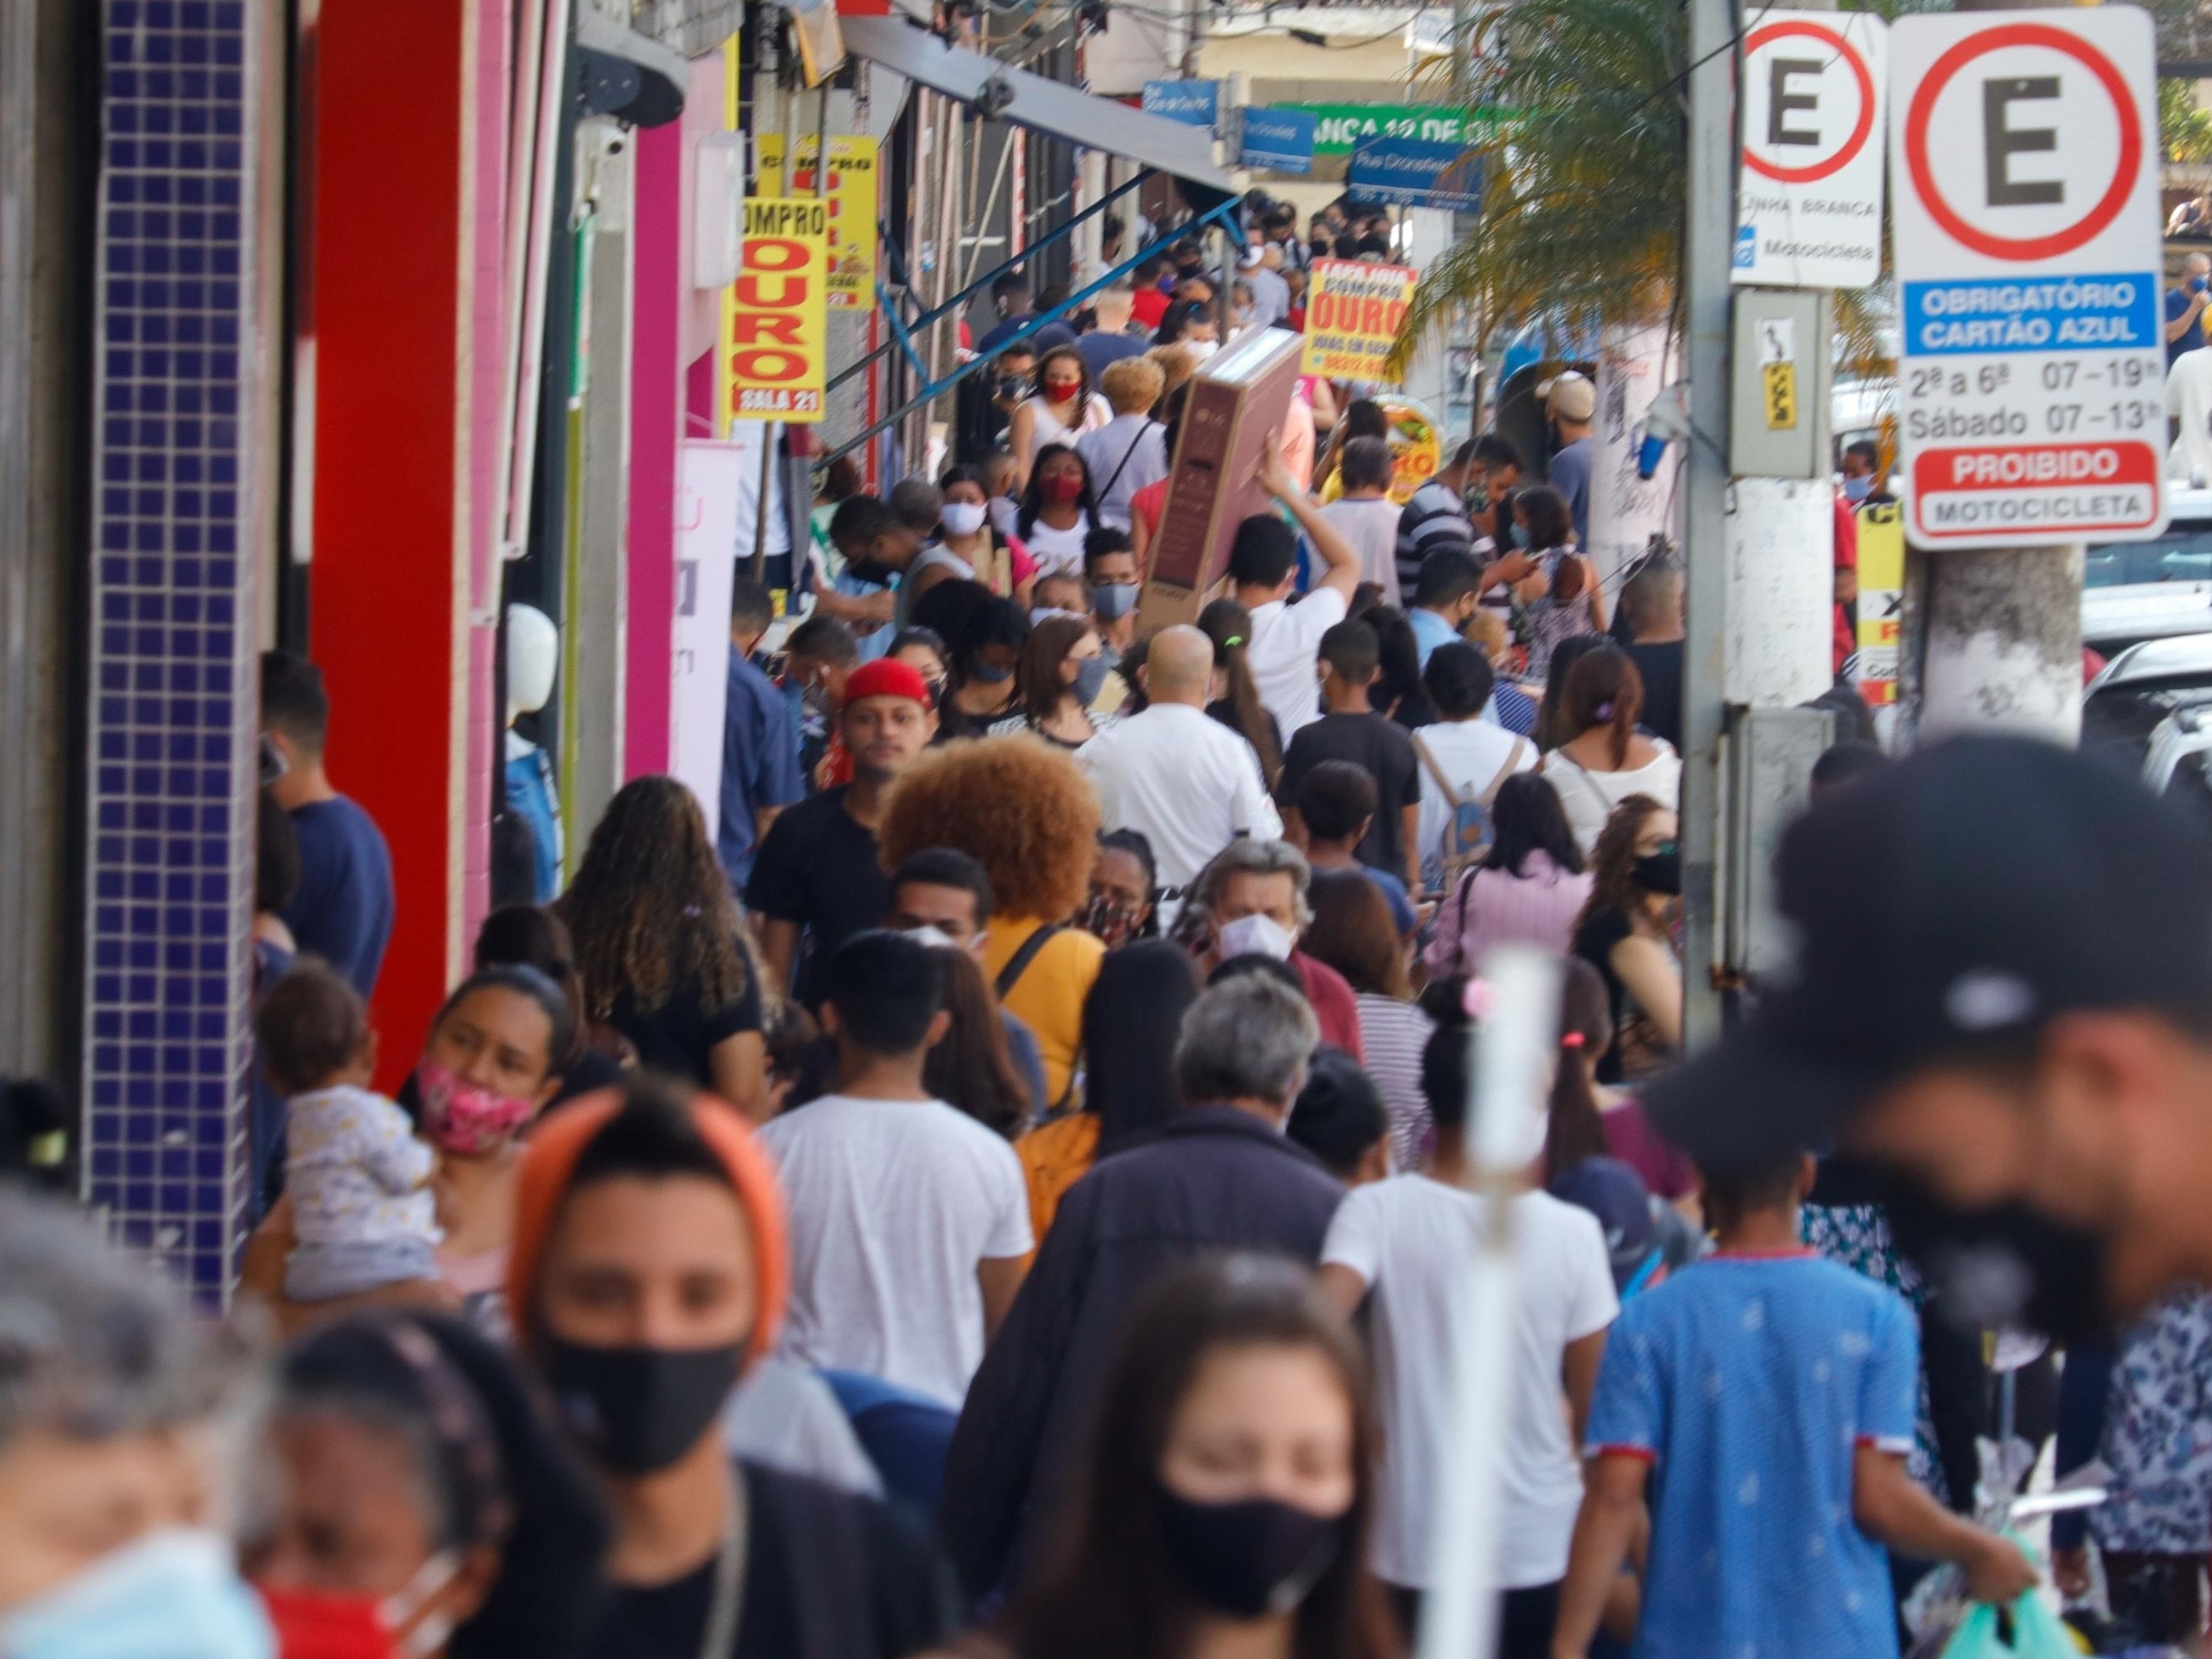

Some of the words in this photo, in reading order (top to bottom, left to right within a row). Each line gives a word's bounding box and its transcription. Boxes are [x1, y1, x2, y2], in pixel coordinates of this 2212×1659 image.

[1767, 59, 1822, 145] E
[1982, 76, 2065, 207] E
[743, 204, 824, 235] OMPRO
[1764, 239, 1874, 261] Motocicleta
[731, 238, 811, 381] OURO
[1920, 276, 2136, 317] OBRIGATÓRIO
[1312, 292, 1409, 338] OURO
[1920, 312, 2052, 349] CARTÃO
[2057, 317, 2138, 343] AZUL
[740, 388, 790, 411] SALA
[794, 390, 818, 410] 21
[1950, 372, 1967, 395] a
[1909, 405, 2028, 439] Sábado
[1953, 448, 2120, 484] PROIBIDO
[1935, 494, 2143, 523] MOTOCICLETA
